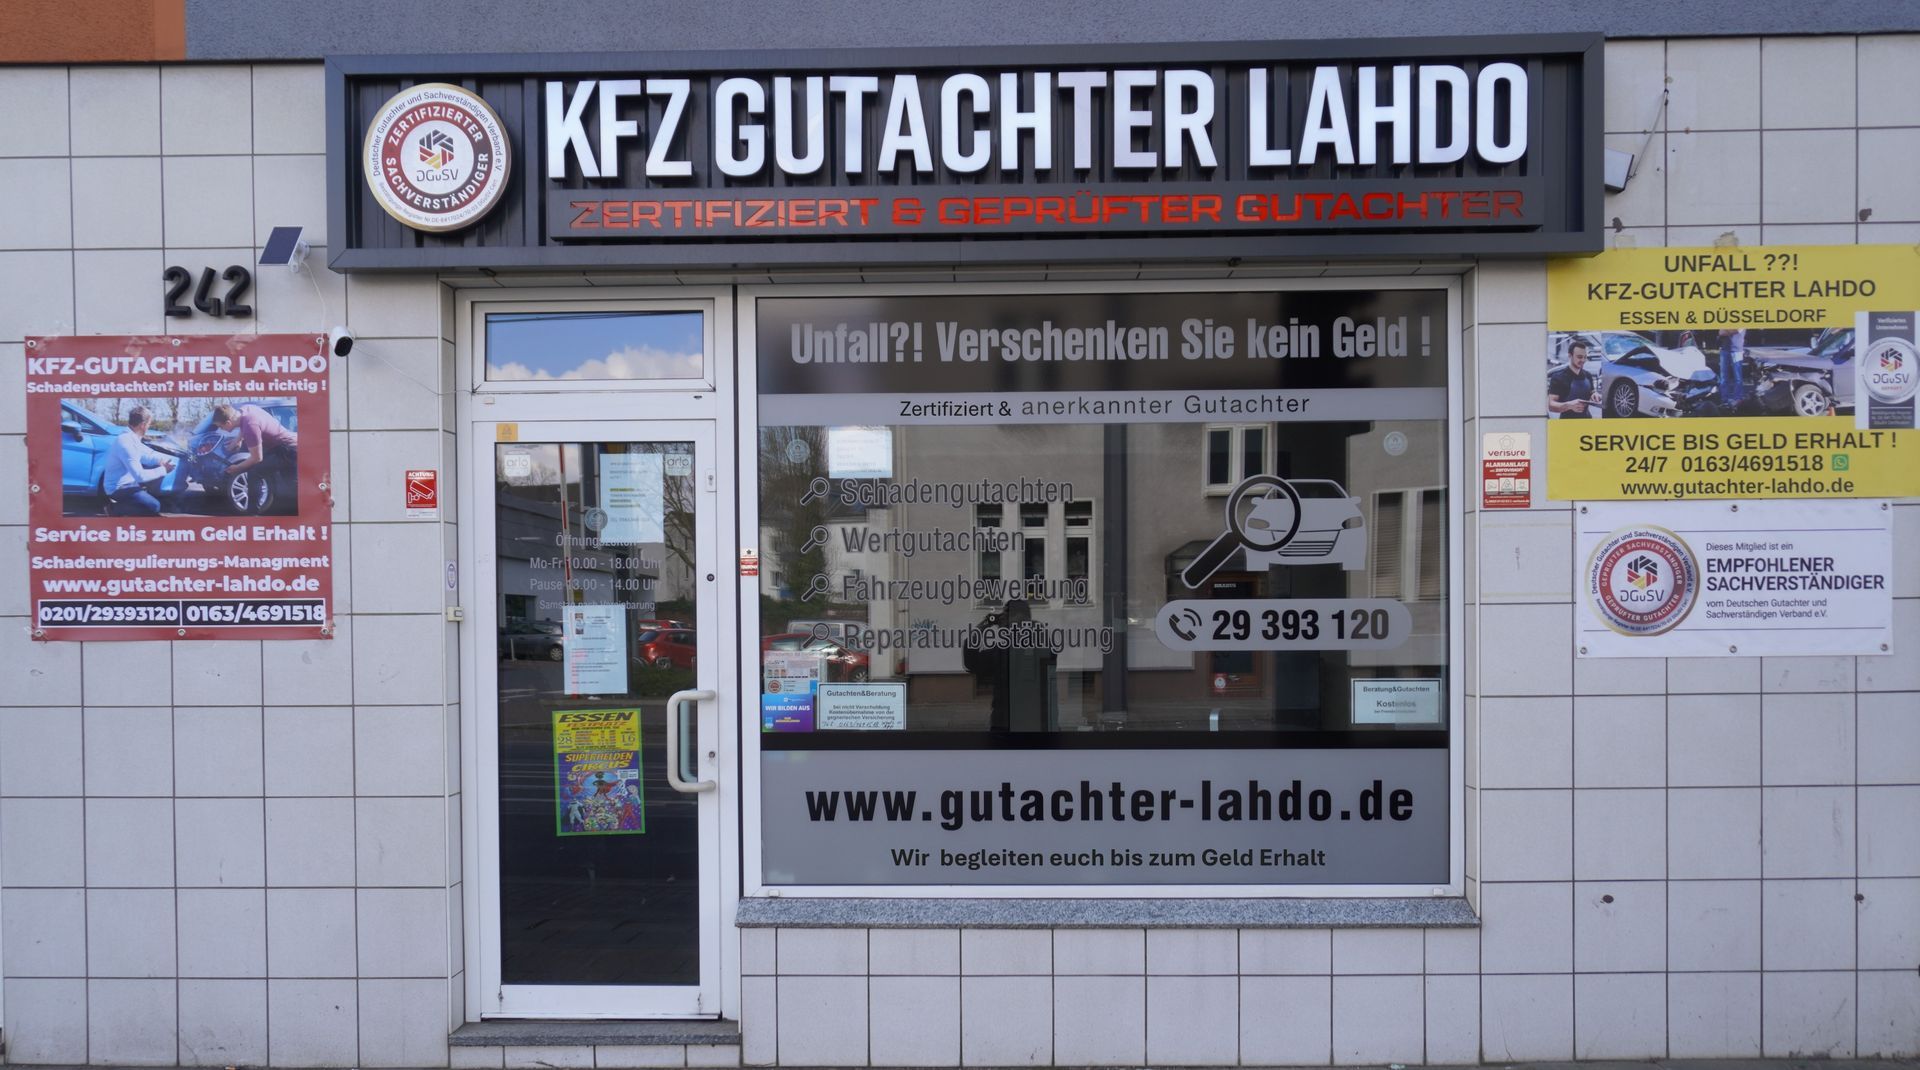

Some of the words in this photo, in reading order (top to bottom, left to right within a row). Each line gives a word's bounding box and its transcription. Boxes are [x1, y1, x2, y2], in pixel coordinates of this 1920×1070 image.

[378, 102, 407, 135] Gutachter
[407, 92, 422, 106] und
[487, 123, 503, 156] Verband
[388, 105, 484, 147] ZERTIFIZIERTER
[545, 78, 692, 179] KFZ
[715, 69, 1218, 177] GUTACHTER
[1248, 62, 1528, 166] LAHDO
[386, 152, 489, 210] SACHVERSTÄNDIGER
[569, 199, 879, 230] ZERTIFIZIERT
[891, 197, 926, 226] &
[938, 191, 1222, 226] GEPRÜFTER
[1235, 190, 1525, 223] GUTACHTER
[1664, 253, 1756, 273] UNFALL
[1763, 253, 1799, 272] ??!
[162, 264, 252, 318] 242
[1587, 280, 1786, 302] KFZ-GUTACHTER
[1793, 278, 1877, 298] LAHDO
[1620, 310, 1680, 325] ESSEN
[1685, 310, 1698, 325] &
[1703, 307, 1827, 324] DÜSSELDORF
[791, 321, 922, 364] Unfall?!
[936, 320, 1168, 363] Verschenken
[1181, 316, 1235, 361] Sie
[1247, 317, 1320, 359] kein
[1332, 315, 1408, 358] Geld
[1421, 316, 1431, 357] !
[28, 355, 234, 376] KFZ-GUTACHTER
[239, 355, 327, 375] LAHDO
[27, 380, 175, 395] Schadengutachten?
[178, 380, 210, 393] Hier
[213, 380, 242, 393] bist
[245, 380, 265, 393] du
[268, 379, 318, 394] richtig
[322, 379, 327, 392] !
[900, 400, 994, 417] Zertifiziert
[998, 400, 1012, 417] &
[1022, 395, 1172, 417] anerkannter
[1184, 394, 1311, 415] Gutachter
[1579, 434, 1676, 452] SERVICE
[1683, 434, 1720, 451] BIS
[1726, 433, 1788, 450] GELD
[1794, 432, 1884, 449] ERHALT
[1891, 432, 1897, 448] !
[1487, 449, 1526, 457] verisure
[1625, 455, 1669, 474] 24/7
[1681, 454, 1824, 473] 0163/4691518
[840, 476, 1075, 509] Schadengutachten
[1621, 478, 1855, 499] www.gutachter-lahdo.de
[34, 526, 113, 543] Service
[116, 525, 148, 543] bis
[151, 528, 197, 542] zum
[201, 525, 249, 542] Geld
[252, 525, 317, 542] Erhalt
[321, 525, 328, 541] !
[842, 526, 1026, 559] Wertgutachten
[1706, 542, 1734, 552] Dieses
[1735, 541, 1767, 553] Mitglied
[1768, 542, 1779, 551] ist
[1780, 542, 1794, 551] ein
[32, 554, 330, 573] Schadenregulierungs-Managment
[530, 557, 563, 570] Mo-Fr
[608, 557, 639, 570] 18.00
[643, 557, 662, 570] Uhr
[1706, 556, 1835, 573] EMPFOHLENER
[43, 576, 320, 597] www.gutachter-lahdo.de
[530, 579, 563, 591] Pause
[608, 579, 639, 591] 14.00
[643, 579, 662, 591] Uhr
[842, 574, 1089, 606] Fahrzeugbewertung
[1706, 573, 1885, 591] SACHVERSTÄNDIGER
[40, 605, 177, 623] 0201/29393120
[187, 602, 324, 622] 0163/4691518
[1706, 600, 1724, 608] vom
[1726, 599, 1769, 608] Deutschen
[1771, 599, 1810, 608] Gutachter
[1812, 599, 1828, 608] und
[1706, 609, 1778, 620] Sachverständigen
[1780, 608, 1813, 618] Verband
[1814, 608, 1828, 618] e.V.
[1212, 608, 1251, 641] 29
[1261, 608, 1320, 641] 393
[1331, 608, 1390, 640] 120
[844, 623, 1115, 655] Reparaturbestätigung
[827, 690, 897, 698] Gutachten&Beratung
[558, 712, 633, 723] ESSEN
[557, 736, 574, 746] 28
[621, 733, 637, 744] 16
[565, 752, 633, 762] SUPERHELDEN
[571, 760, 631, 772] CIRCUS
[805, 779, 1415, 831] www.gutachter-lahdo.de
[890, 847, 931, 867] Wir
[939, 847, 1045, 871] begleiten
[1048, 847, 1106, 867] euch
[1109, 847, 1145, 867] bis
[1147, 852, 1196, 867] zum
[1201, 847, 1254, 867] Geld
[1258, 847, 1327, 867] Erhalt
